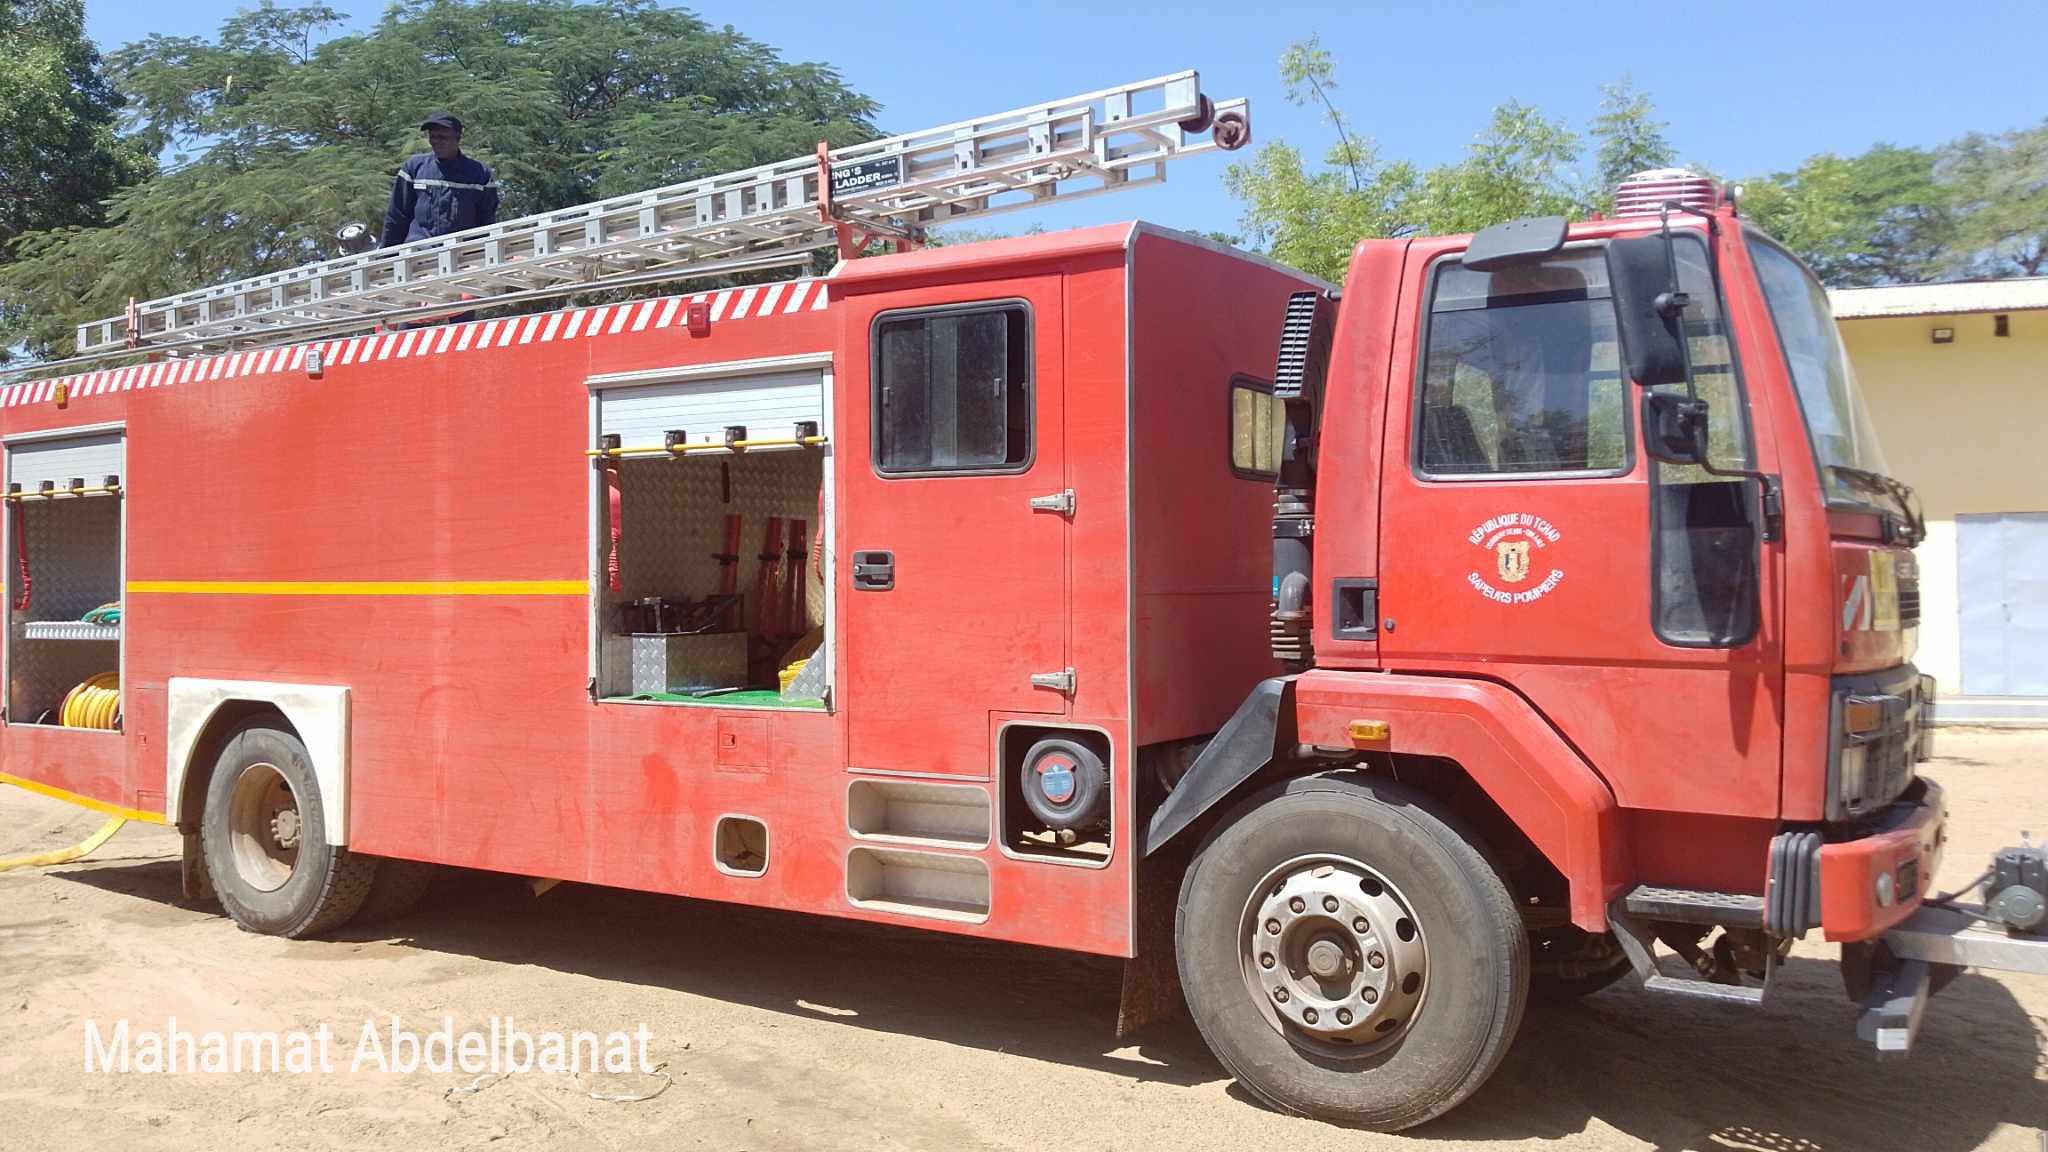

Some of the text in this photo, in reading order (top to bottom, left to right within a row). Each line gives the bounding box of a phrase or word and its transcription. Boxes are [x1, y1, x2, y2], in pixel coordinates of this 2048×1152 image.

[834, 172, 881, 189] LADDER
[1467, 513, 1519, 545] RÉPUBLIQUE
[1520, 513, 1534, 526] DU
[1534, 516, 1561, 542] TCHAD
[1467, 569, 1564, 604] SAPEURS POMPIERS
